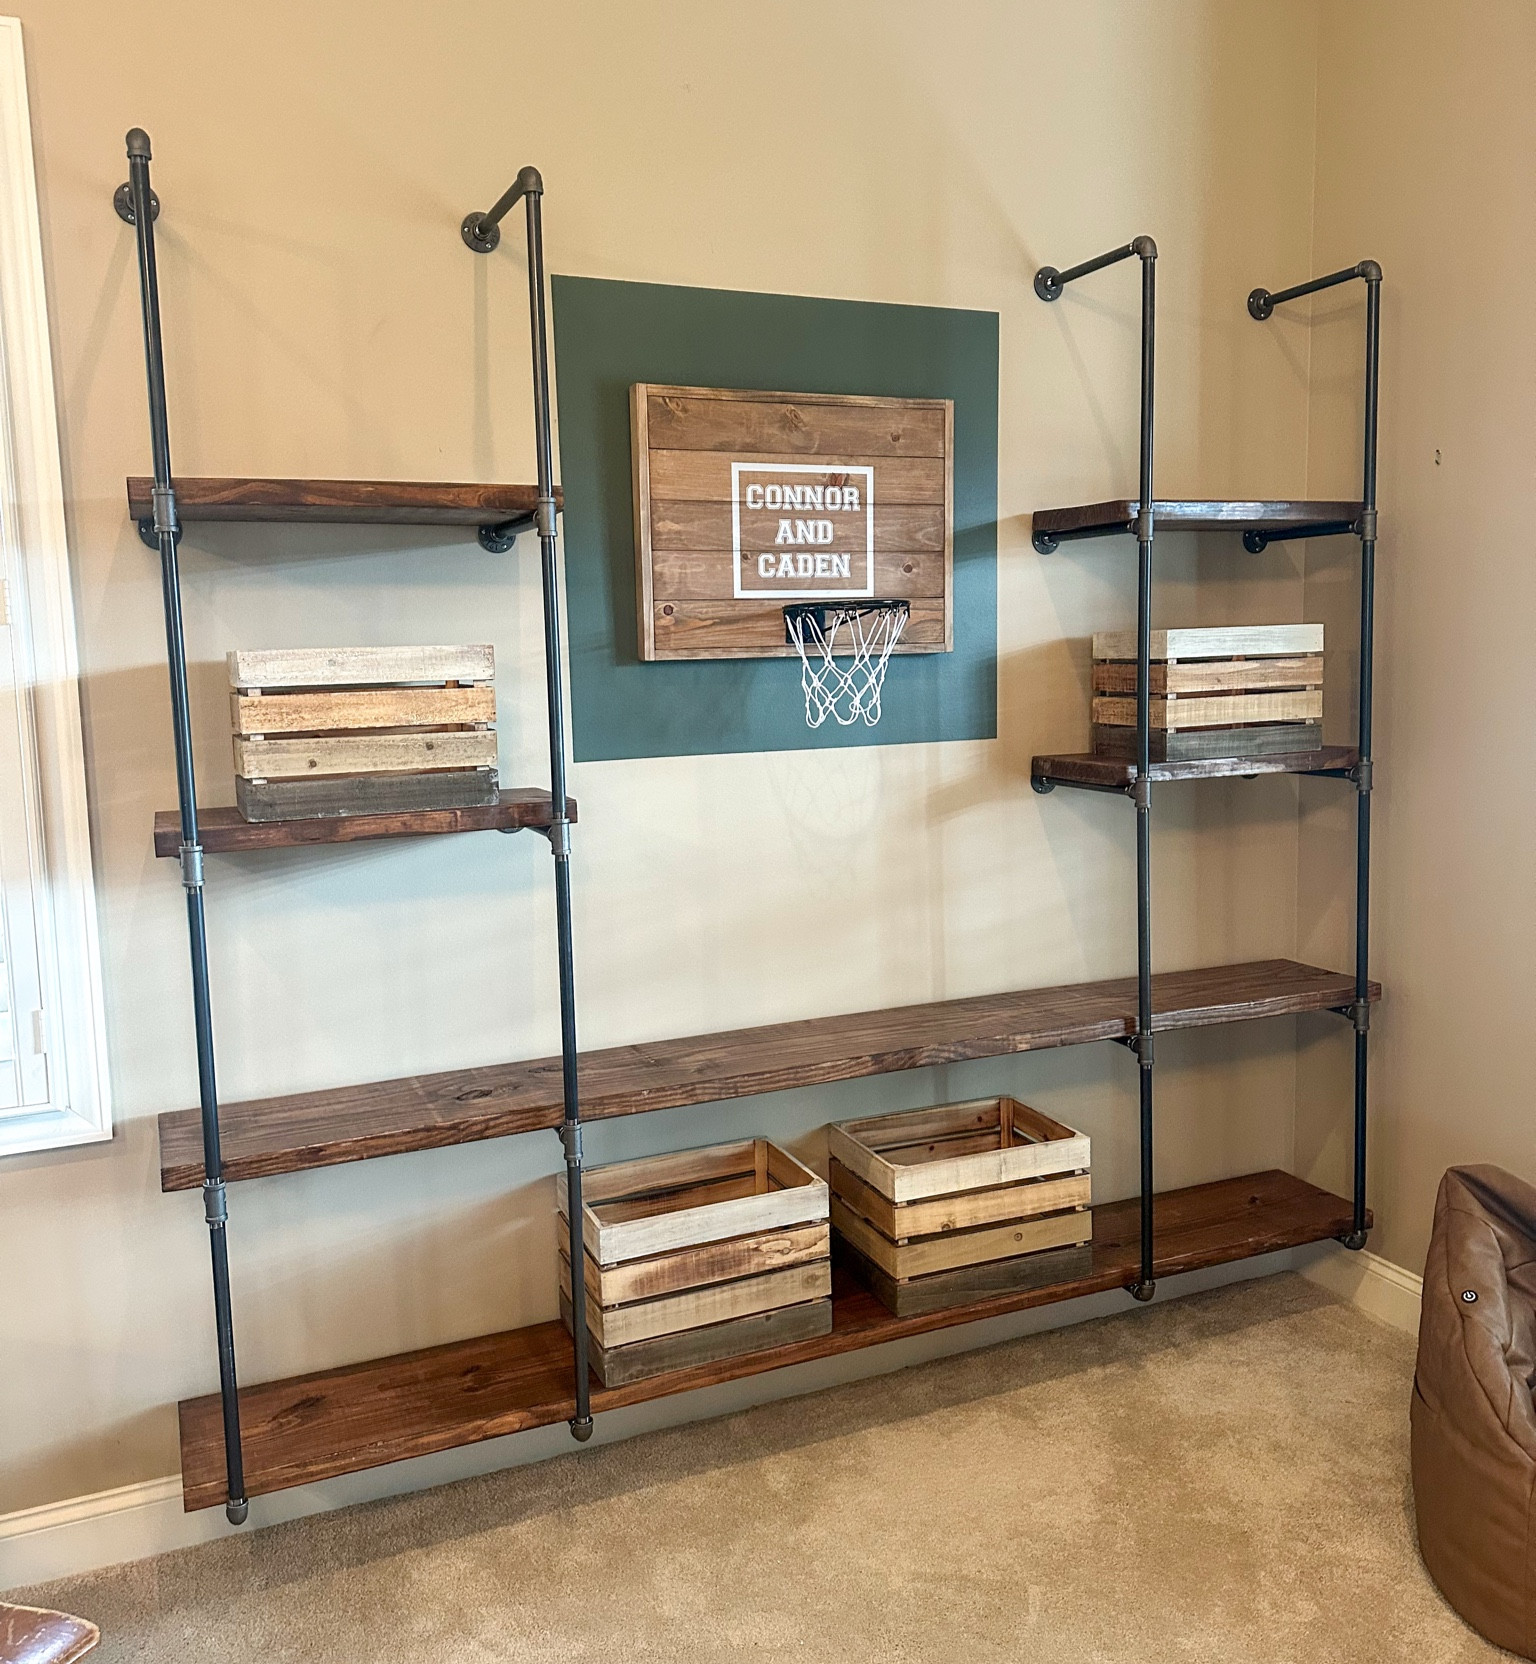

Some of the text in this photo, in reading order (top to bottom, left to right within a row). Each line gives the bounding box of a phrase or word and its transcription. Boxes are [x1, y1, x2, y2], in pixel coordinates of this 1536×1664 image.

[746, 484, 860, 511] CONNOR
[775, 519, 834, 545] AND
[758, 553, 851, 578] CADEN
